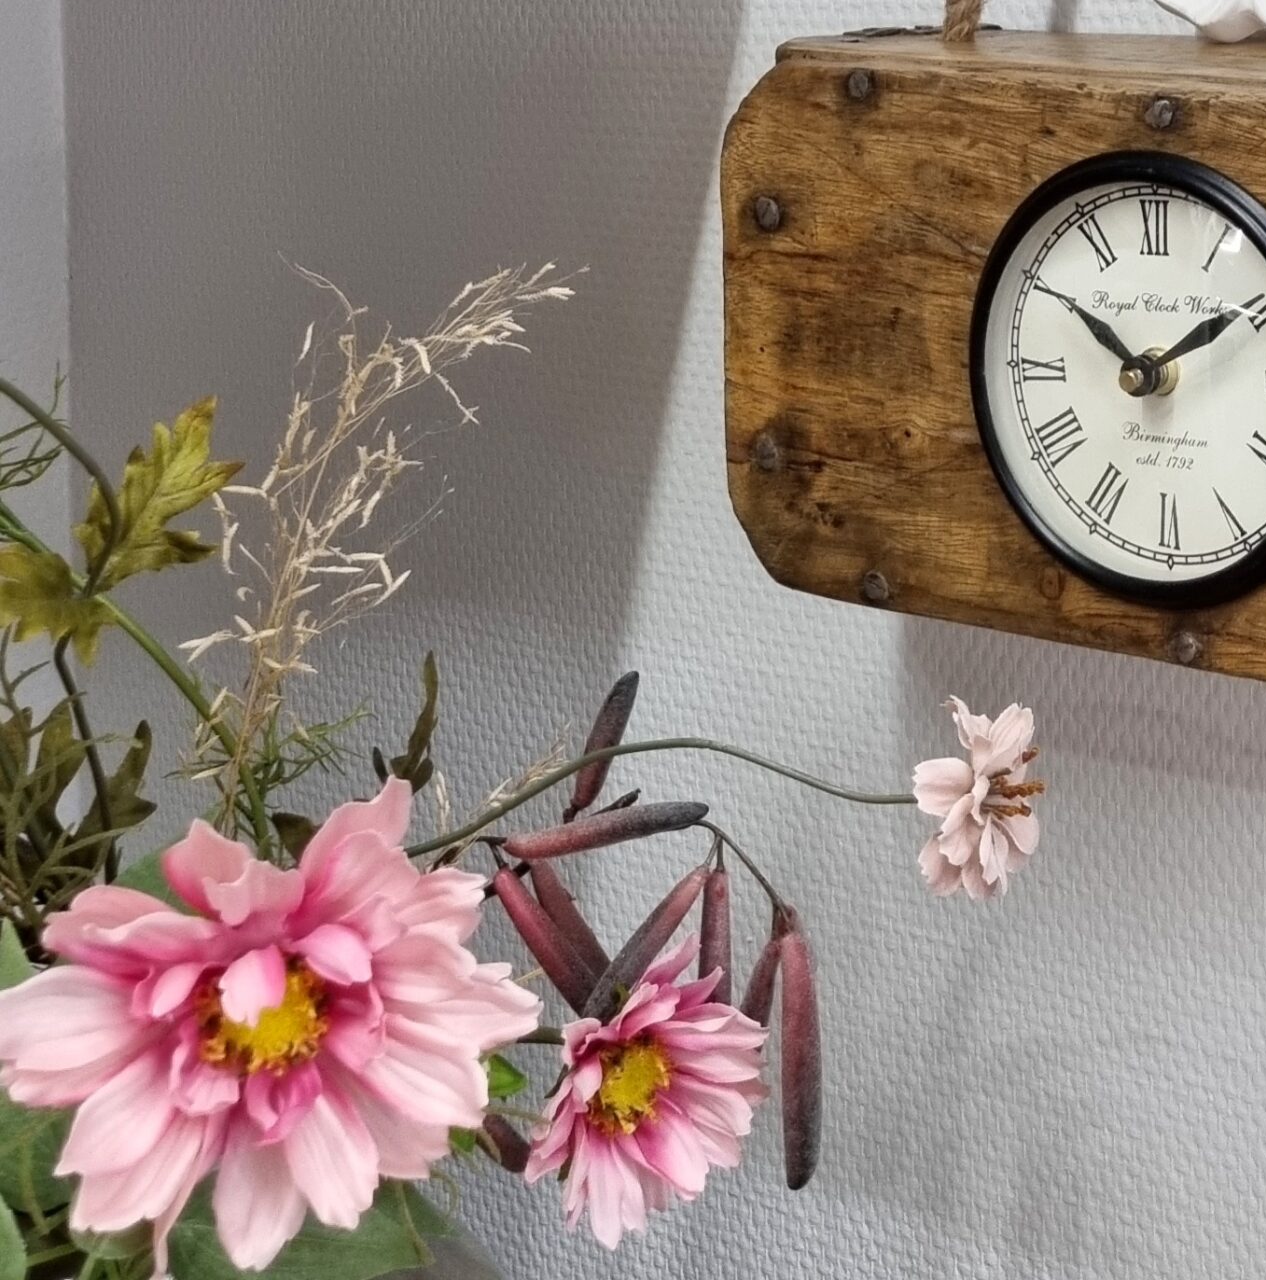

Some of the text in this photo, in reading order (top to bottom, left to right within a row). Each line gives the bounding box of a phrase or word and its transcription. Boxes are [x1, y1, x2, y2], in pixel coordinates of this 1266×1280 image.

[1077, 213, 1118, 272] XI
[1139, 199, 1169, 256] XII
[1091, 290, 1139, 317] Royal
[1141, 293, 1180, 313] Clock
[1021, 356, 1067, 383] IX
[1035, 406, 1088, 468] VIII
[1122, 421, 1208, 452] Birmingham
[1136, 451, 1194, 470] estd. 1792
[1085, 461, 1129, 525] VII
[1159, 492, 1181, 550] VI
[1212, 486, 1247, 541] V
